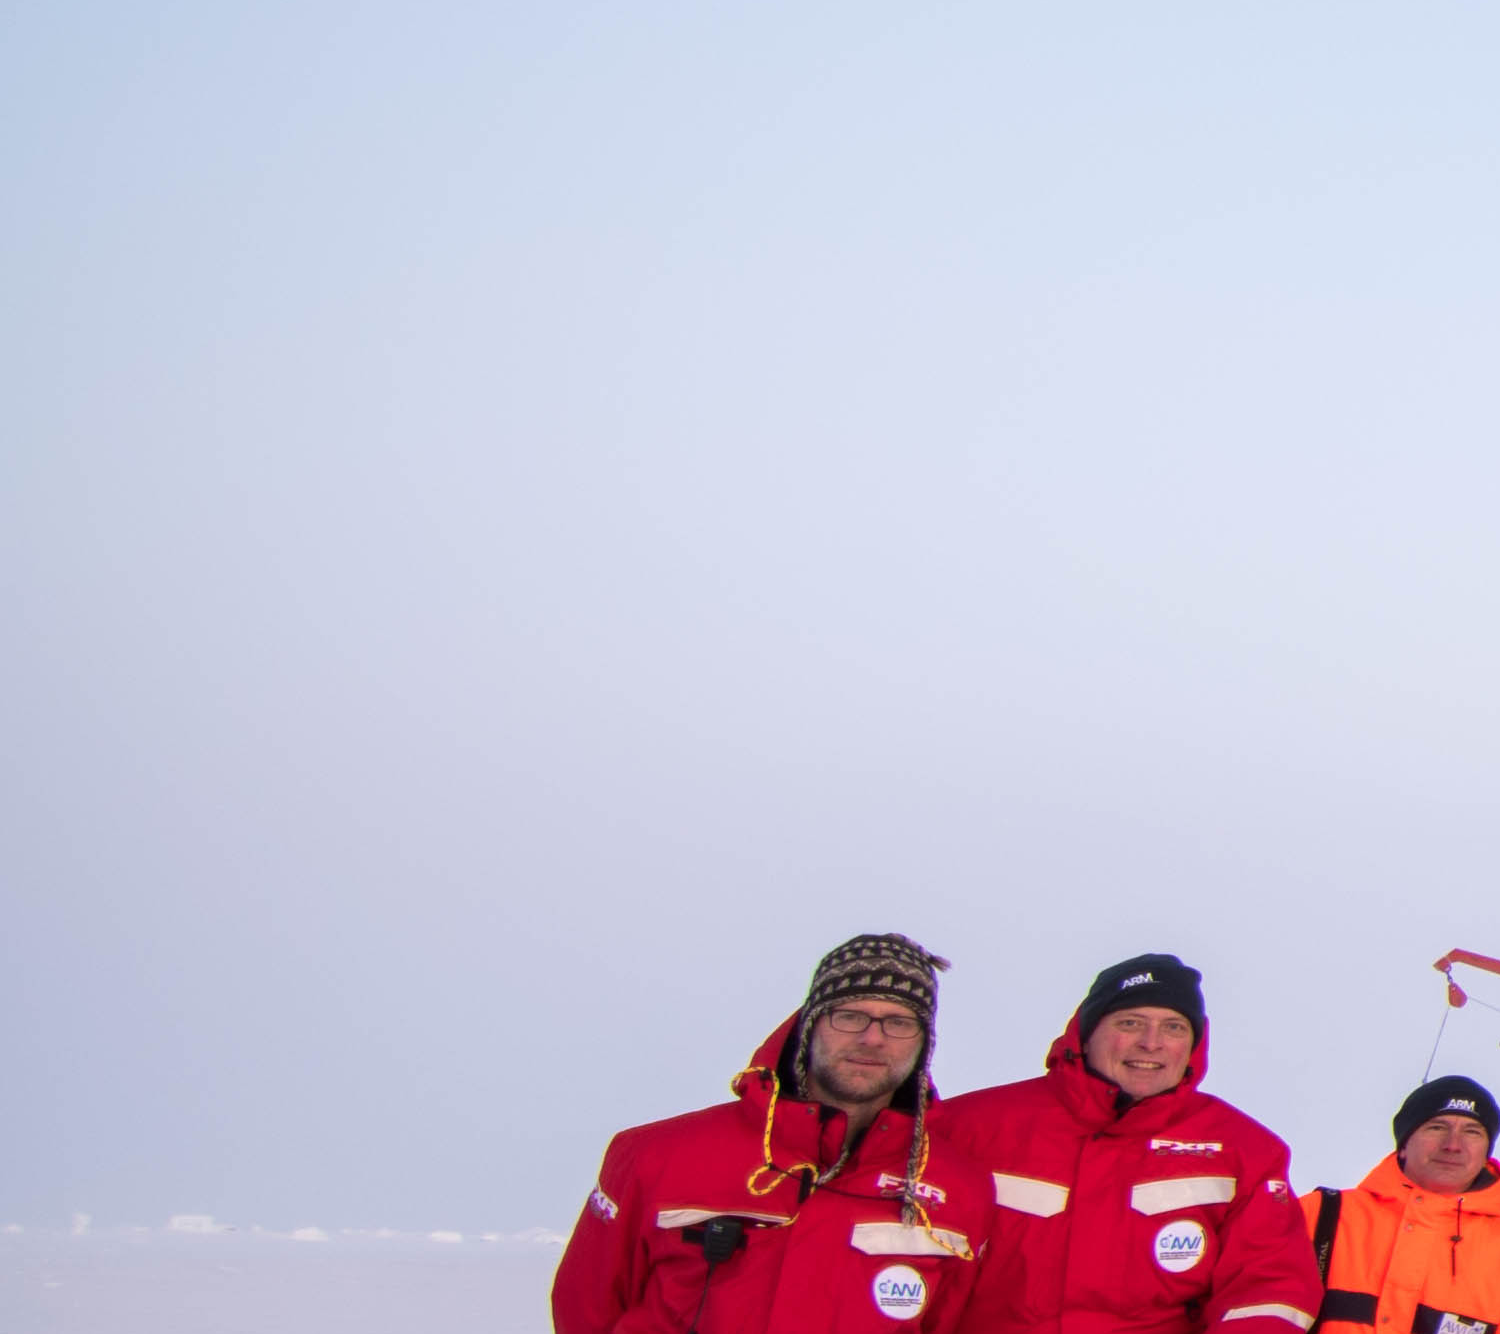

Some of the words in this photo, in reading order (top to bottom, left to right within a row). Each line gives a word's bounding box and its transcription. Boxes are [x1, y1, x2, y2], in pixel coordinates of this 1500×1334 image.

[1122, 972, 1153, 989] ARM
[1448, 1099, 1475, 1111] ARM
[1150, 1138, 1223, 1152] FXR
[1171, 1236, 1202, 1250] AWI
[891, 1283, 922, 1297] AWI
